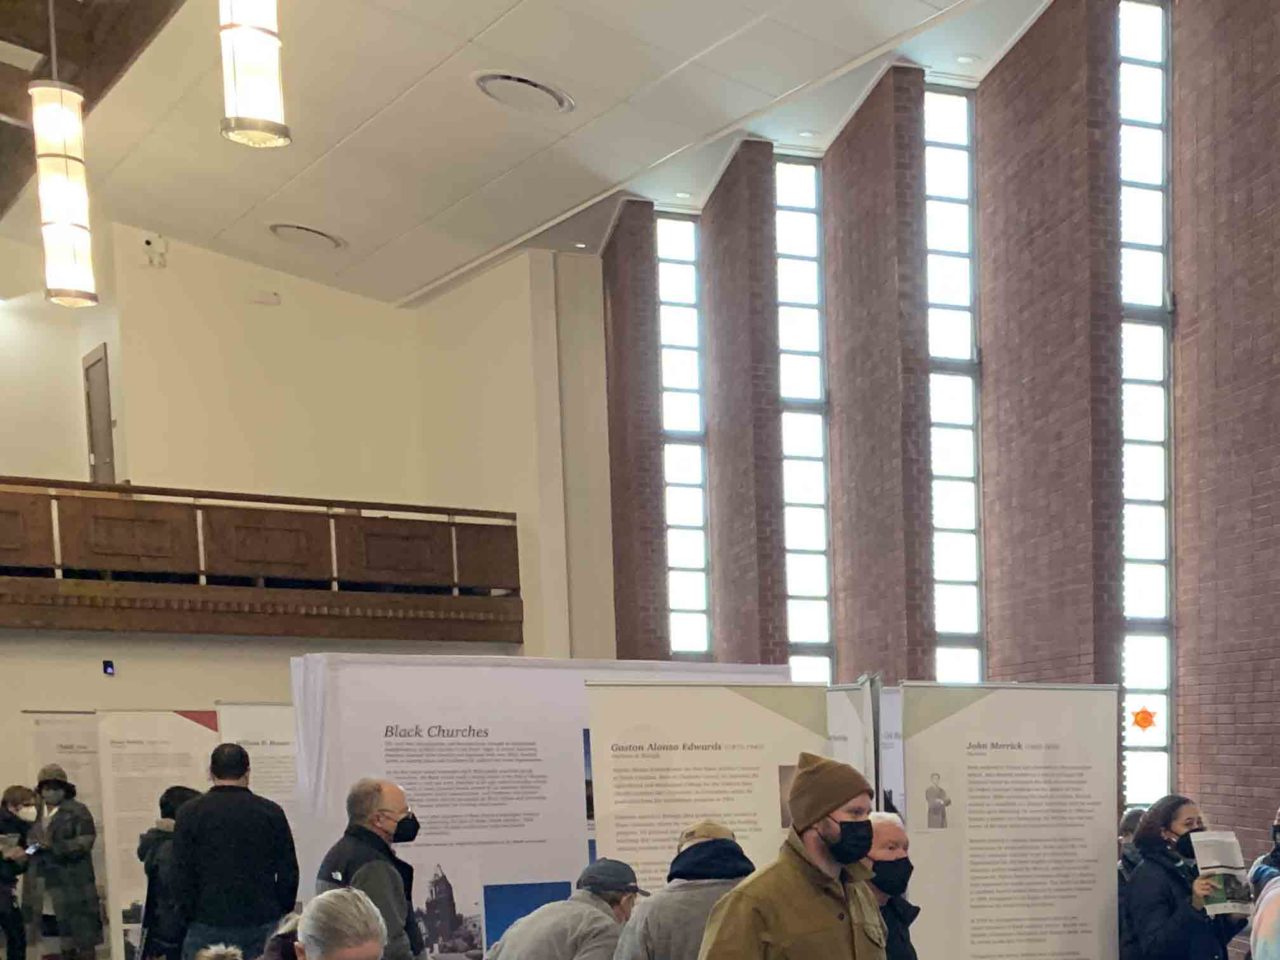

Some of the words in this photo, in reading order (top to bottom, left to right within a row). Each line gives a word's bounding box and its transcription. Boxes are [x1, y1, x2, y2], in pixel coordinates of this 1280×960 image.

[384, 725, 423, 738] Black
[427, 725, 489, 738] Churches
[611, 743, 645, 752] Gaston
[682, 742, 722, 752] Edwards
[966, 742, 988, 750] John
[990, 742, 1023, 750] Merrick
